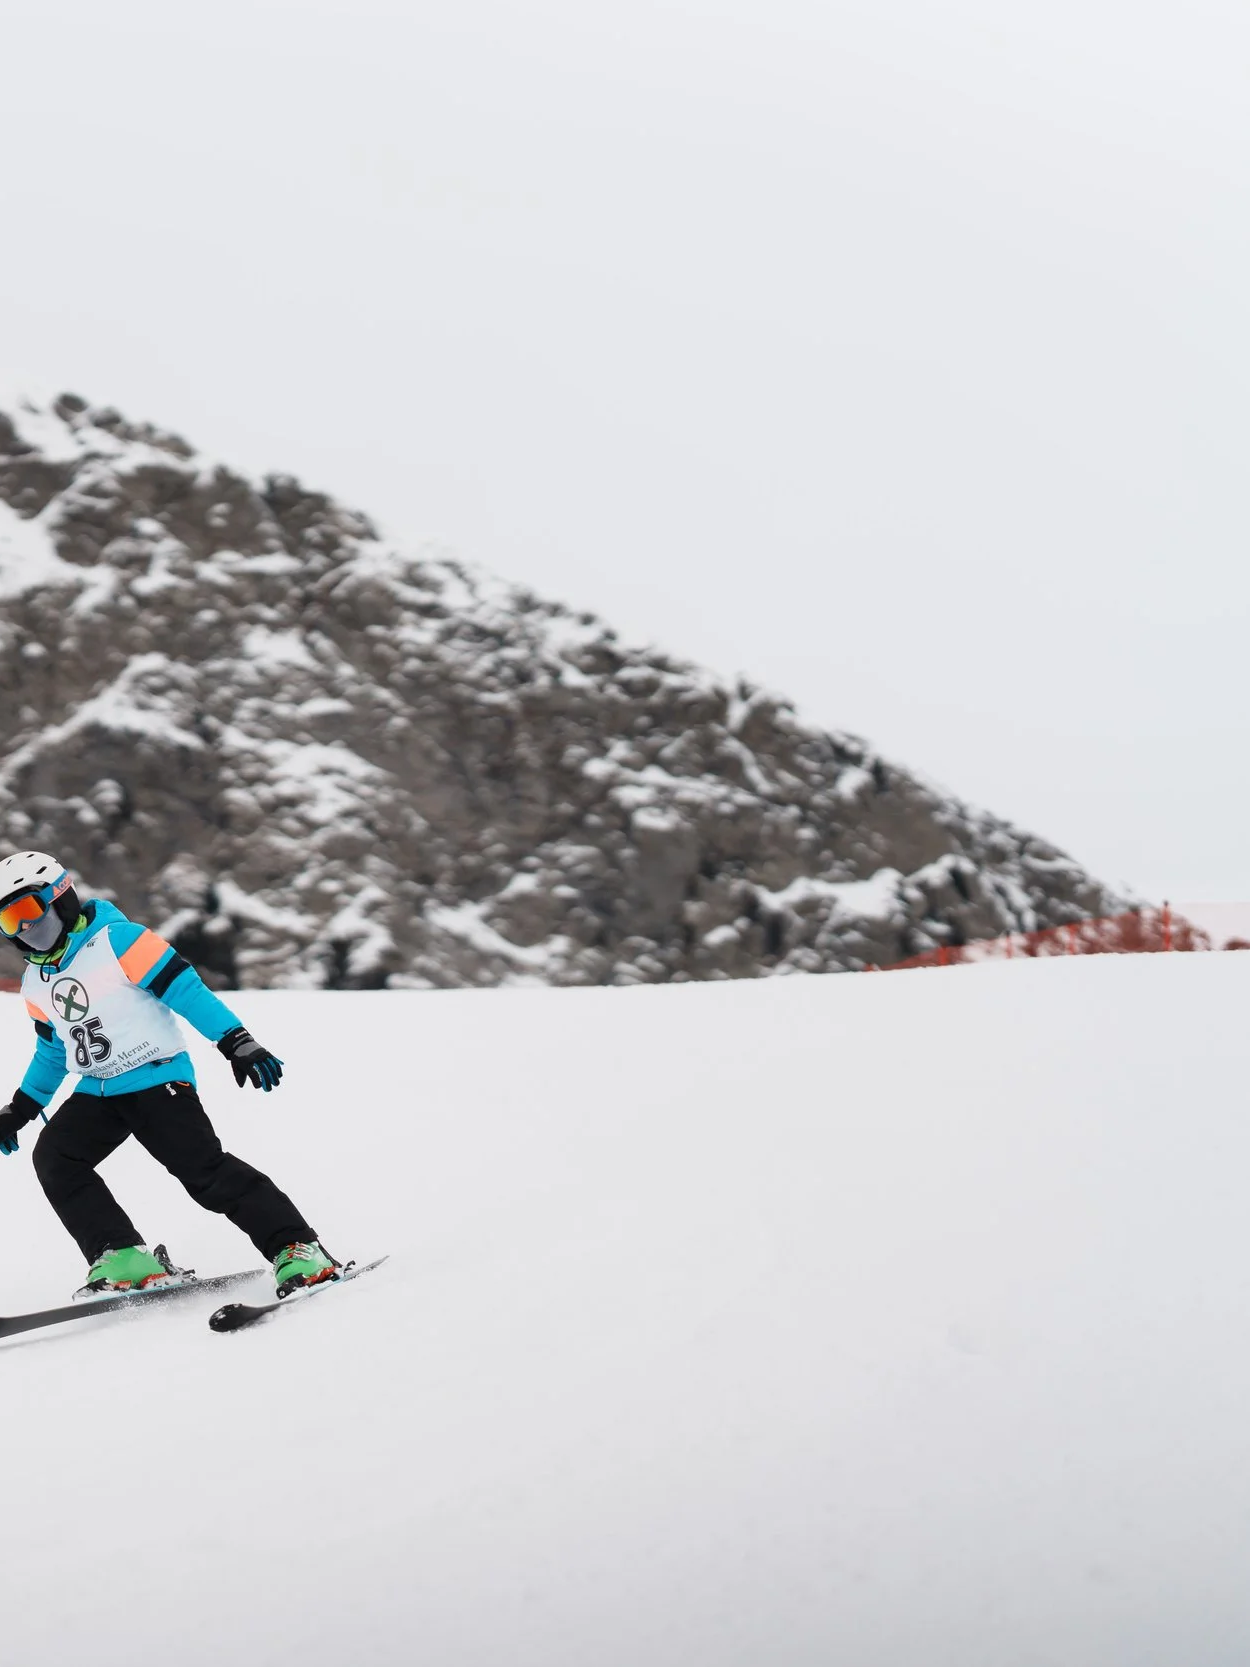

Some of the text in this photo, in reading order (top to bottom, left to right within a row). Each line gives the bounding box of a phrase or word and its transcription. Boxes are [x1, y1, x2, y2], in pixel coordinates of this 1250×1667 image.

[70, 1017, 112, 1068] 85
[117, 1041, 151, 1061] Meran
[122, 1046, 160, 1069] Merano
